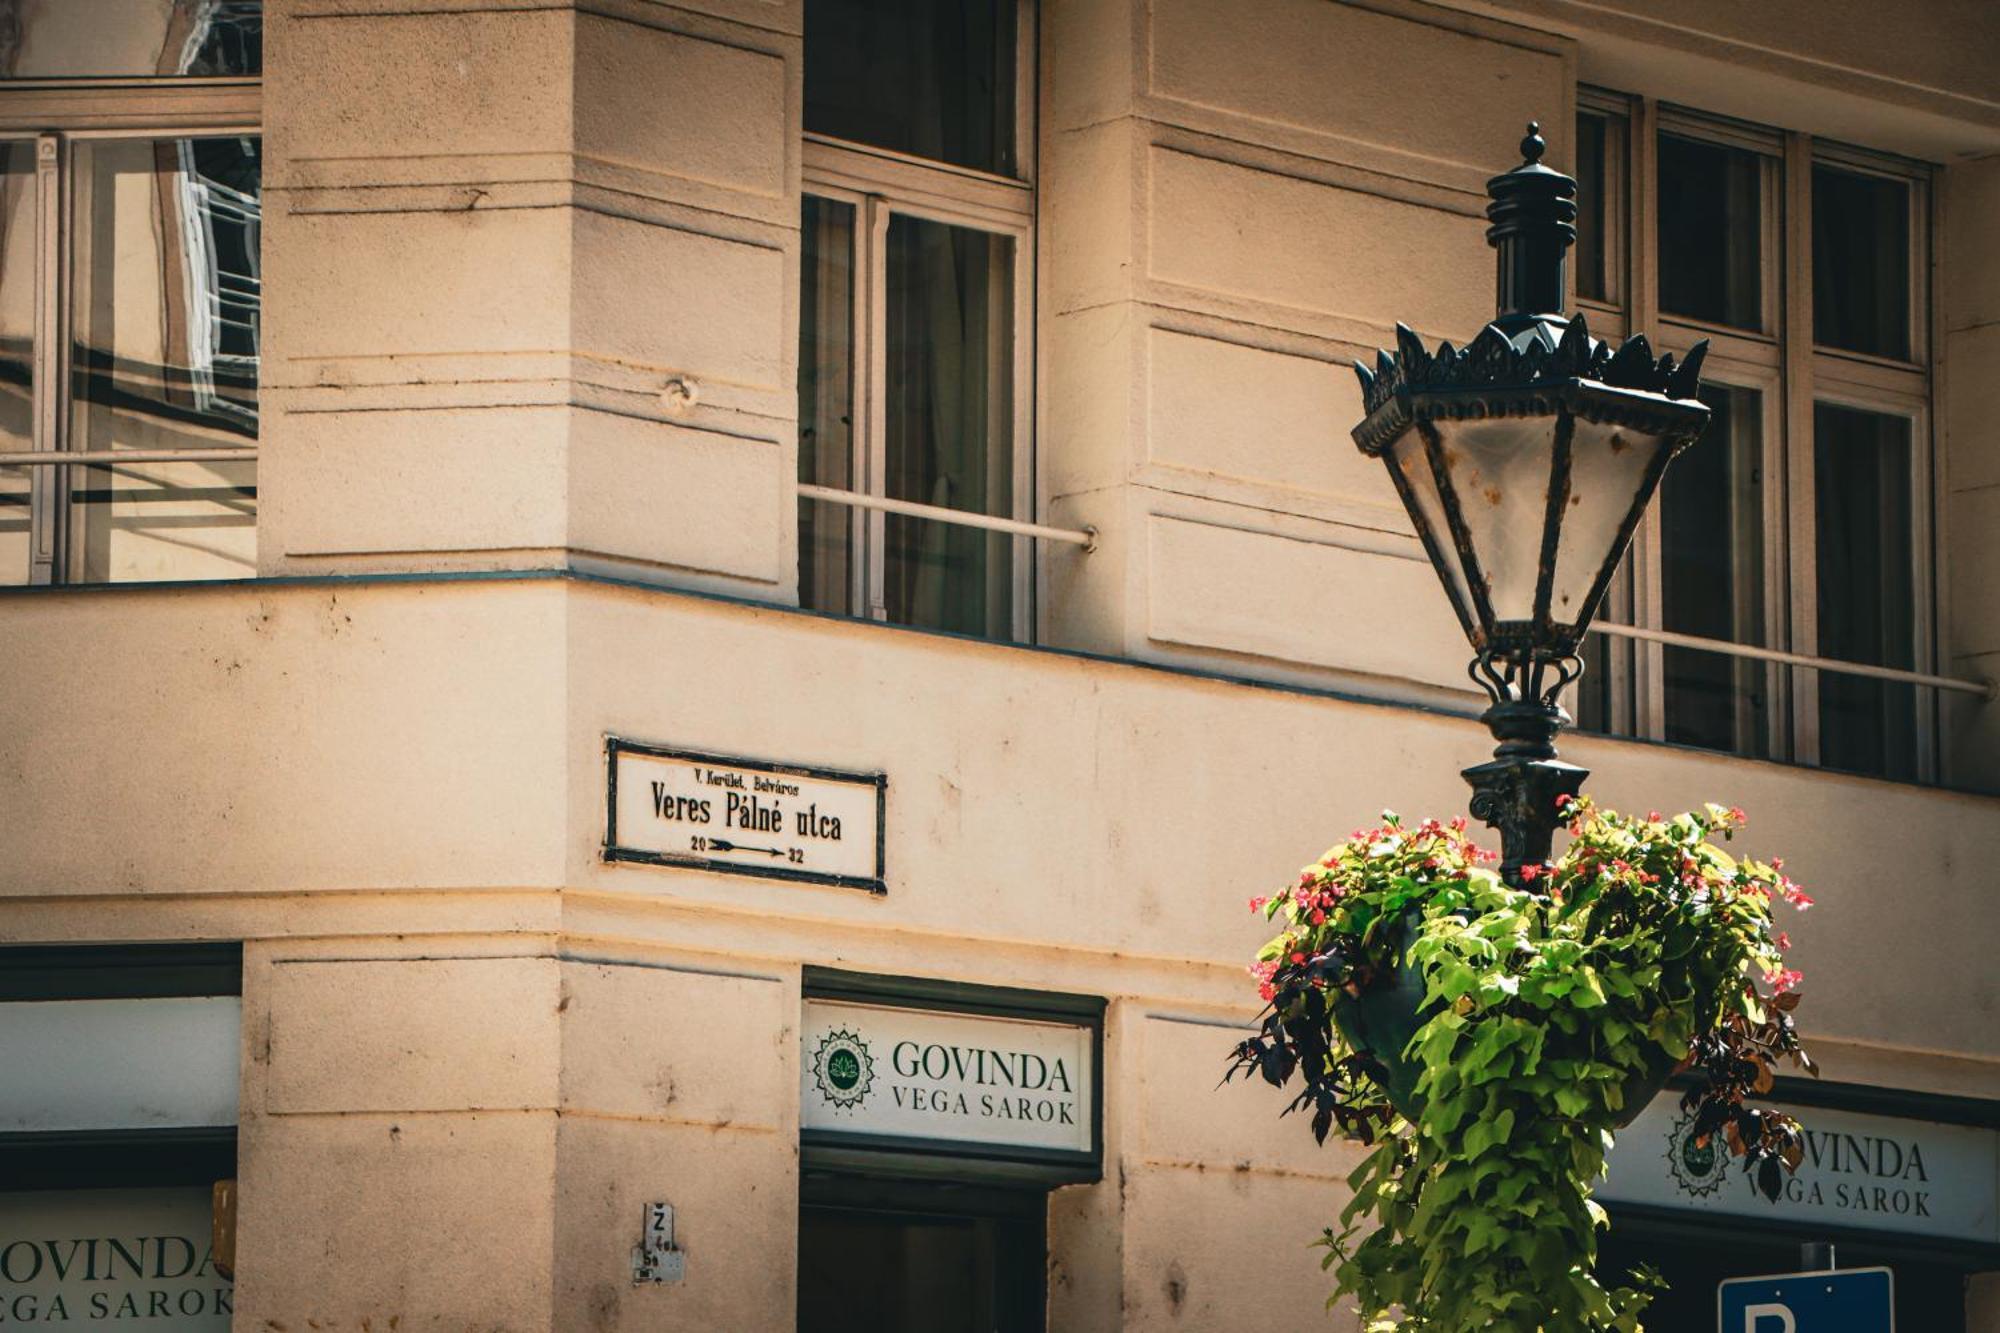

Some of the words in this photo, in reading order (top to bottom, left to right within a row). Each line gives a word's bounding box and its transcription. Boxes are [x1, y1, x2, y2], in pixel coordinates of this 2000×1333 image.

[694, 768, 703, 784] V.
[753, 775, 800, 797] Belváros
[651, 781, 711, 824] Veres
[726, 792, 782, 833] Pálné
[797, 803, 842, 840] utca
[691, 835, 706, 852] 20
[788, 848, 804, 864] 32
[892, 1040, 1073, 1093] GOVINDA
[892, 1086, 969, 1115] VEGA
[981, 1094, 1074, 1125] SAROK
[1778, 1129, 1929, 1182] VINDA
[1747, 1173, 1824, 1206] VGA
[1836, 1183, 1931, 1217] SAROK
[653, 1211, 665, 1231] Z
[0, 1291, 69, 1323] GA
[90, 1288, 233, 1321] SAROK
